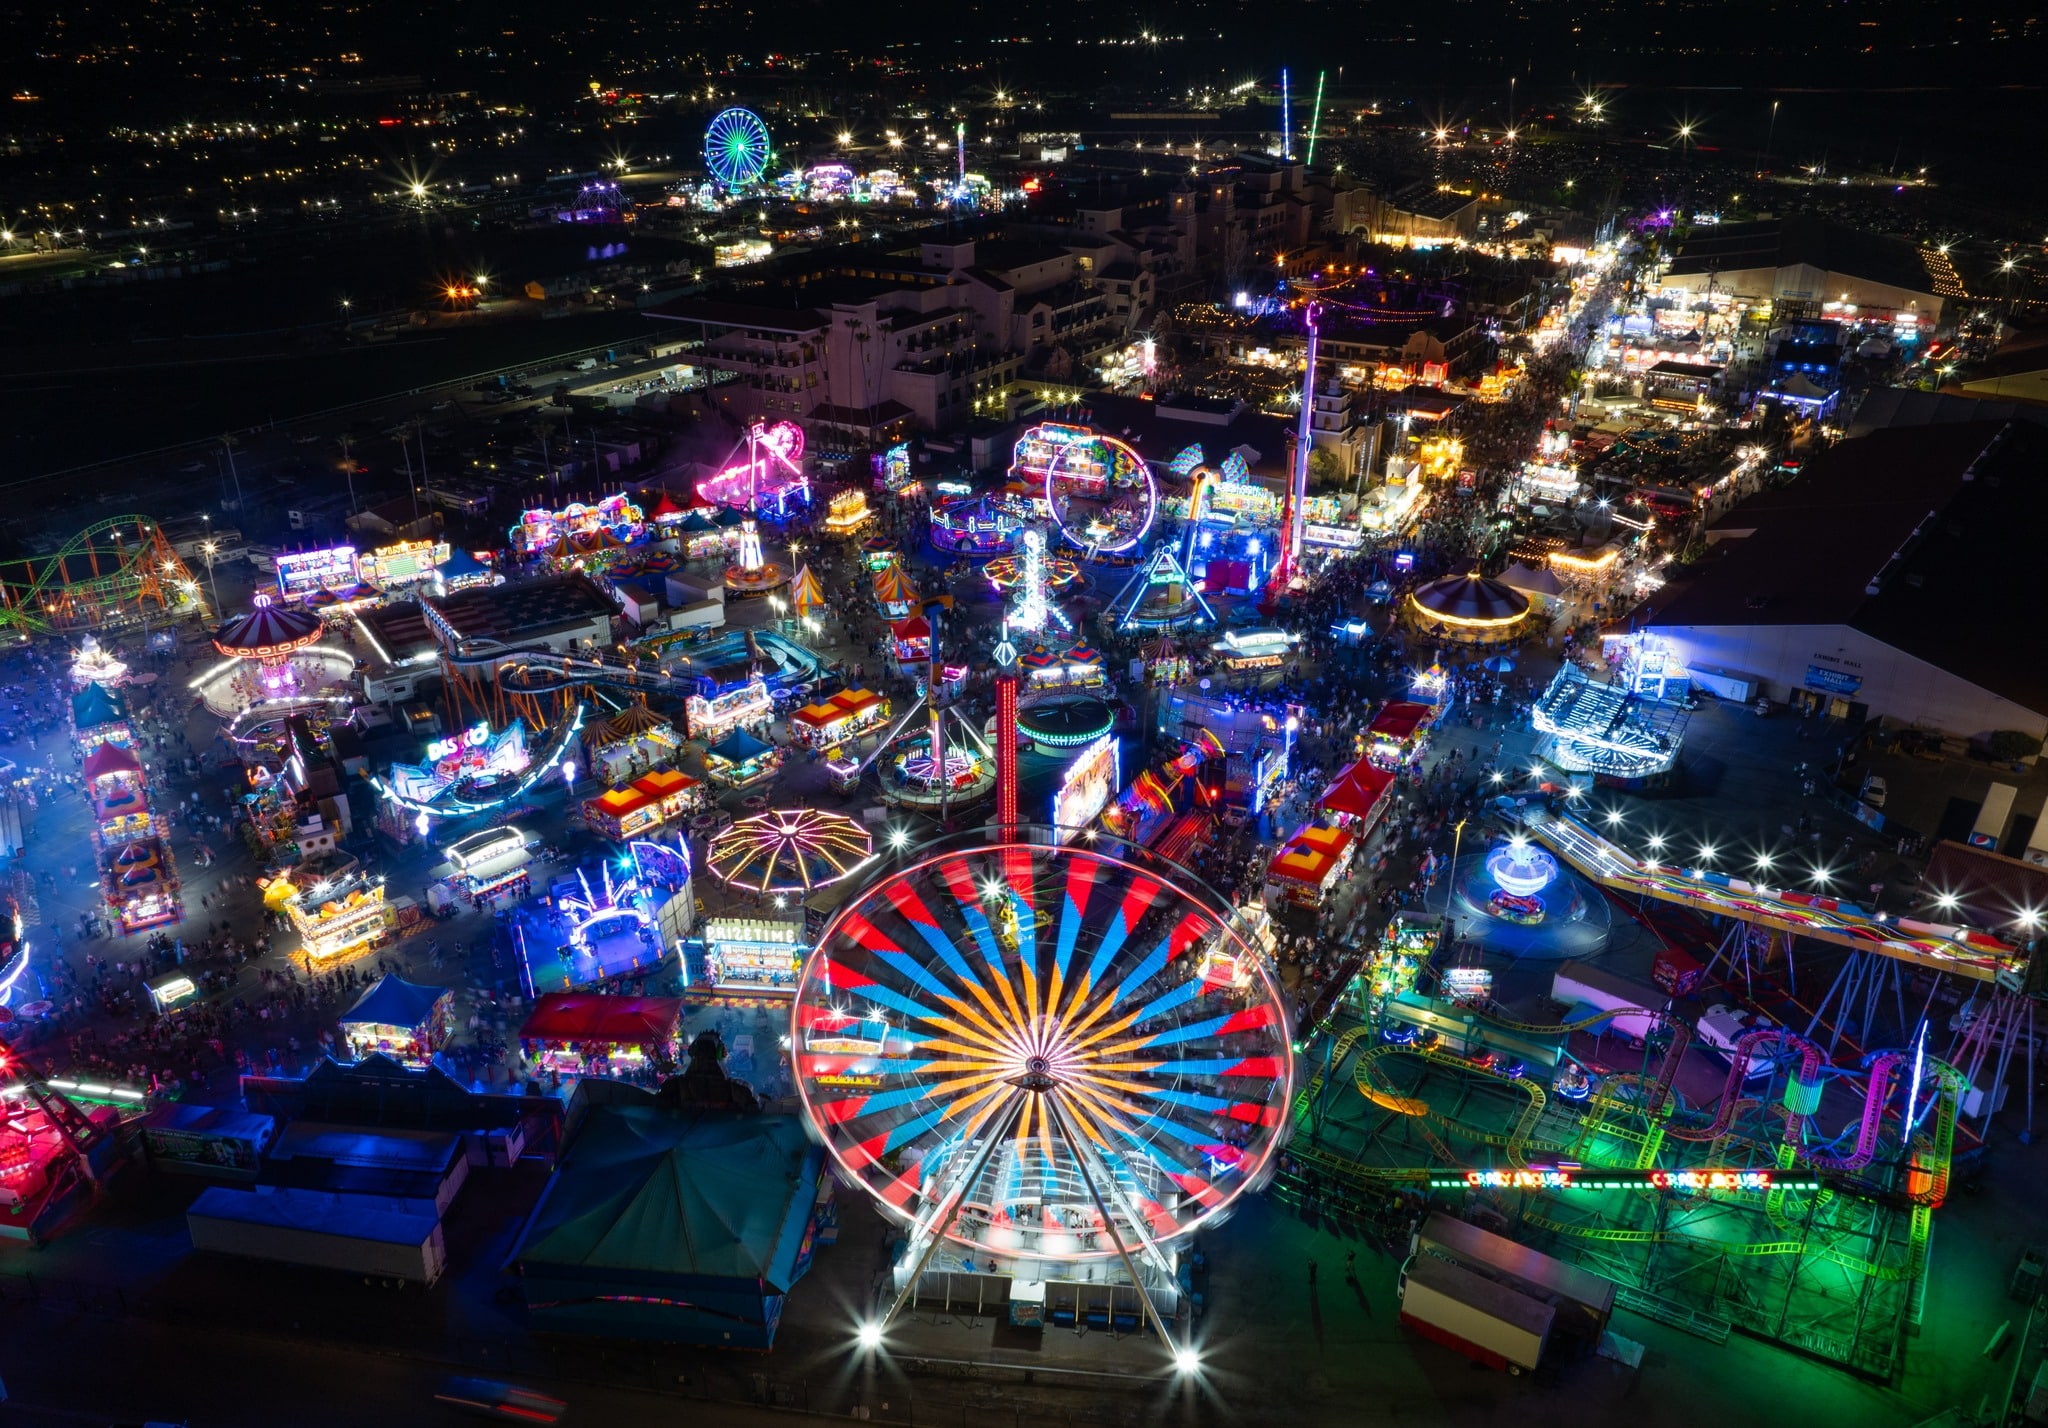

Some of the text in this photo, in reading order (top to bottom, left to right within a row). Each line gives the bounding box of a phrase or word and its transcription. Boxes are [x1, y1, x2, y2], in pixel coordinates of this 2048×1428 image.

[1813, 653, 1862, 668] EXHIBIT HALL
[1819, 669, 1849, 681] EXHIBIT
[1823, 676, 1842, 685] HALL
[1467, 1172, 1512, 1186] CRAZY
